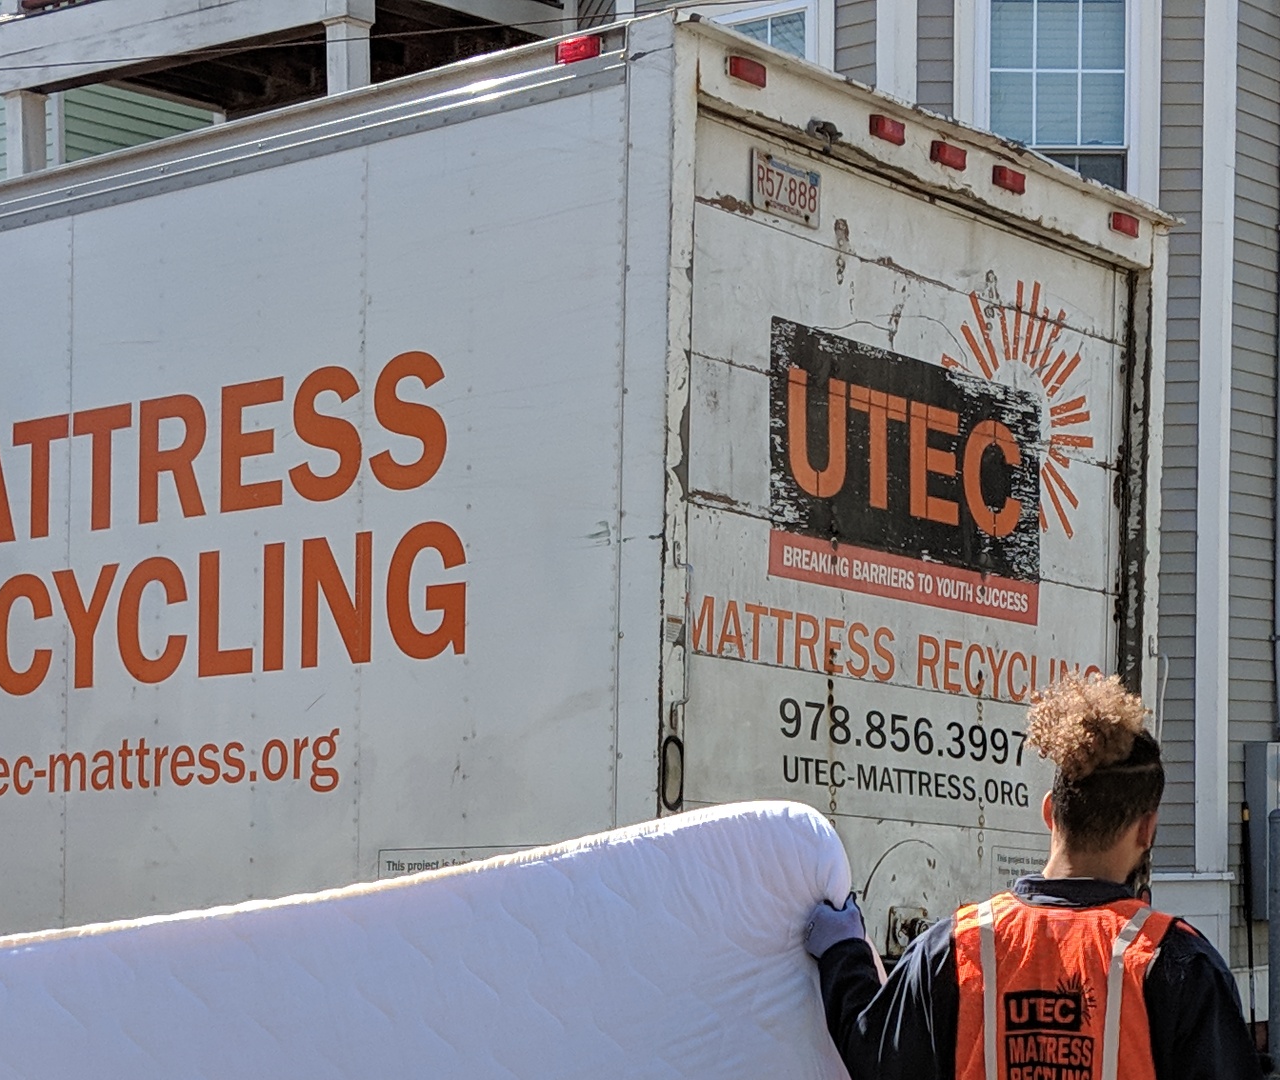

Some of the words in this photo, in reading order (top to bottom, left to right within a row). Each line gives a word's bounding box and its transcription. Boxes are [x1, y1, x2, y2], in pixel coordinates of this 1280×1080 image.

[788, 366, 1021, 537] UTEC
[783, 545, 849, 577] BREAKING
[852, 561, 915, 592] BARRIERS
[918, 574, 933, 593] TO
[936, 578, 974, 601] YOUTH
[975, 587, 1029, 612] SUCCESS
[692, 595, 895, 682] MATTRESS
[918, 634, 1101, 703] RECYCLI
[779, 698, 1028, 767] 978.856.3997
[783, 755, 1029, 807] UTEC-MATTRESS.ORG
[387, 860, 405, 871] This
[407, 859, 439, 873] project
[1009, 999, 1075, 1023] UTEC
